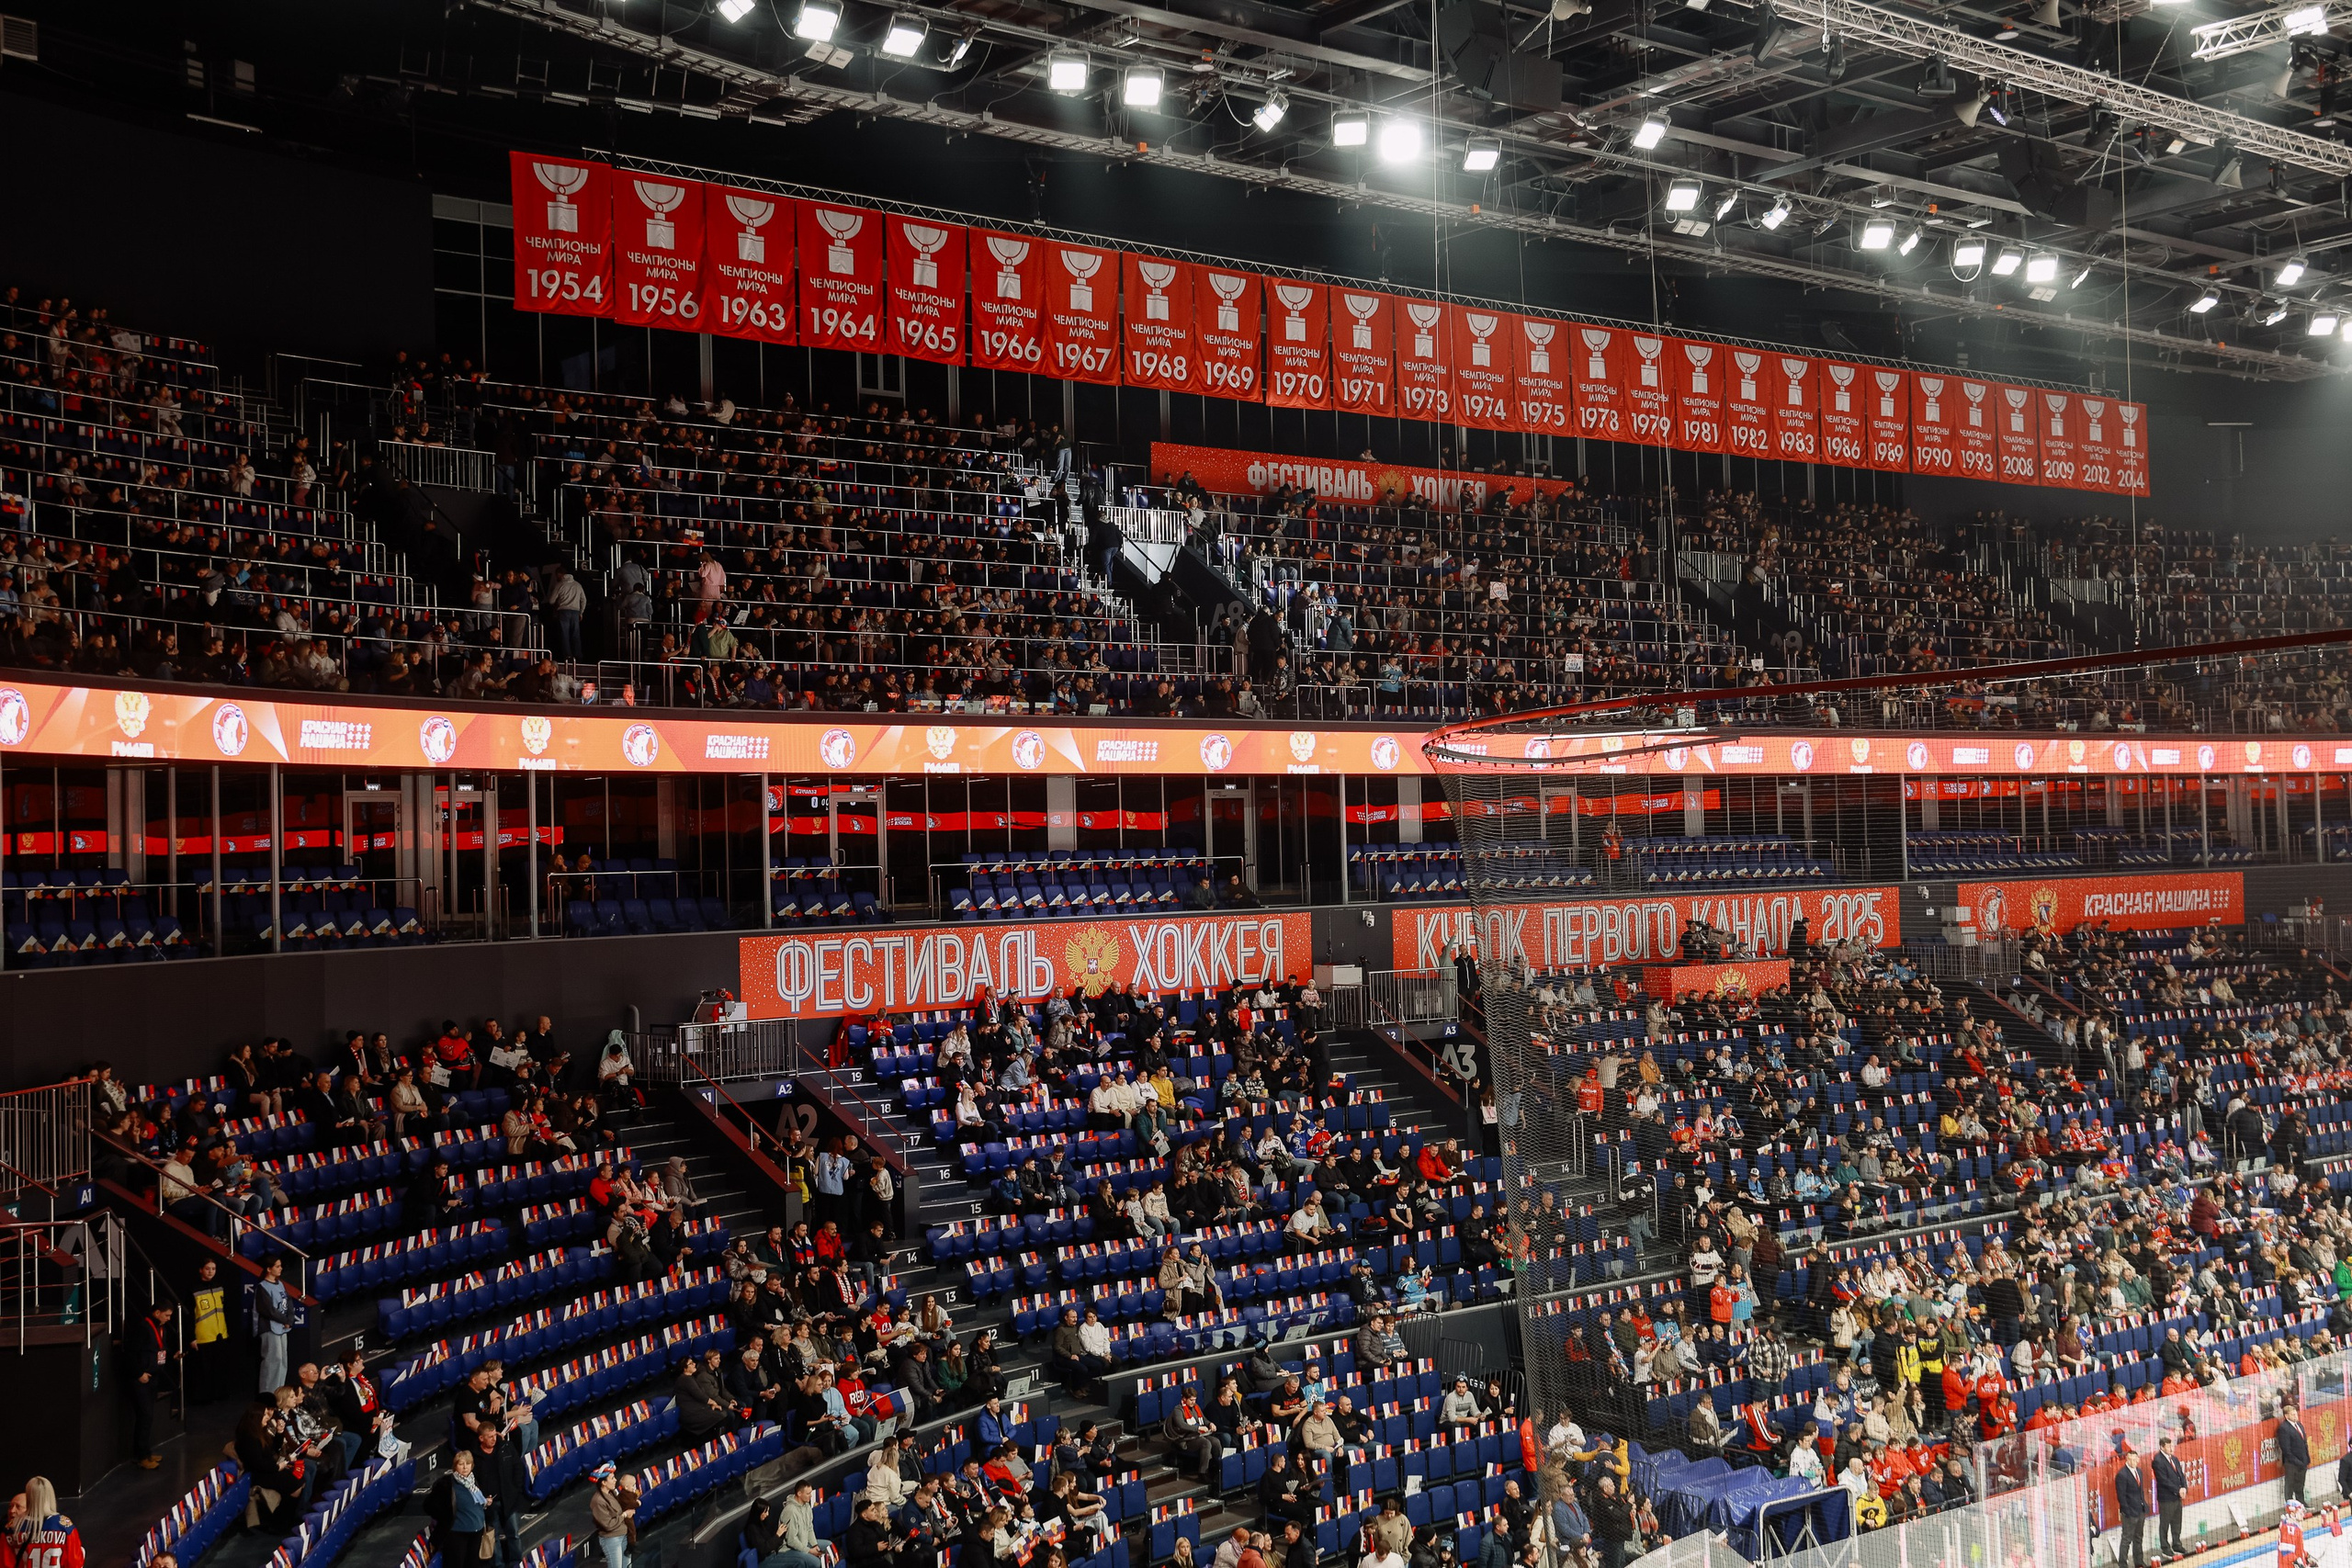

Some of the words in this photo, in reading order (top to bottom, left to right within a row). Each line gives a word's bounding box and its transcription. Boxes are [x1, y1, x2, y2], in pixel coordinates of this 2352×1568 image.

[526, 236, 601, 254] ЧЕМПИОНЫ
[547, 252, 582, 265] МИРА
[628, 252, 696, 271] ЧЕМПИОНЫ
[646, 266, 678, 281] МИРА
[719, 264, 783, 286] ЧЕМПИОНЫ
[527, 268, 603, 304] 1954
[737, 279, 768, 295] МИРА
[809, 277, 873, 295] ЧЕМПИОНЫ
[628, 283, 699, 319] 1956
[828, 290, 857, 306] МИРА
[896, 288, 956, 309] ЧЕМПИОНЫ
[720, 295, 786, 331] 1963
[911, 303, 940, 318] МИРА
[981, 301, 1037, 319] ЧЕМПИОНЫ
[810, 307, 876, 340] 1964
[996, 315, 1023, 328] МИРА
[1054, 314, 1109, 331] ЧЕМПИОНЫ
[897, 317, 956, 352] 1965
[1069, 327, 1095, 340] МИРА
[1131, 323, 1185, 339] ЧЕМПИОНЫ
[981, 330, 1041, 362] 1966
[1147, 336, 1171, 348] МИРА
[1204, 334, 1252, 350] ЧЕМПИОНЫ
[1056, 343, 1111, 372] 1967
[1217, 346, 1240, 358] МИРА
[1273, 345, 1319, 358] ЧЕМПИОНЫ
[1132, 351, 1187, 380] 1968
[1285, 356, 1307, 367] МИРА
[1340, 353, 1386, 367] ЧЕМПИОНЫ
[1204, 361, 1254, 390] 1969
[1352, 364, 1374, 375] МИРА
[1403, 361, 1446, 375] ЧЕМПИОНЫ
[1415, 373, 1435, 383] МИРА
[1460, 370, 1504, 383] ЧЕМПИОНЫ
[1519, 377, 1562, 389] ЧЕМПИОНЫ
[1274, 371, 1322, 399] 1970
[1341, 378, 1385, 405] 1971
[1472, 381, 1492, 391] МИРА
[1579, 383, 1617, 396] ЧЕМПИОНЫ
[1405, 386, 1448, 412] 1973
[1531, 388, 1552, 398] МИРА
[1589, 393, 1609, 402] МИРА
[1631, 389, 1668, 401] ЧЕМПИОНЫ
[1463, 394, 1506, 420] 1974
[1641, 400, 1659, 410] МИРА
[1682, 397, 1719, 409] ЧЕМПИОНЫ
[1730, 403, 1766, 415] ЧЕМПИОНЫ
[1521, 401, 1565, 426] 1975
[1580, 407, 1619, 431] 1978
[1691, 407, 1711, 416] МИРА
[1779, 409, 1813, 420] ЧЕМПИОНЫ
[1632, 412, 1670, 437] 1979
[1826, 415, 1860, 426] ЧЕМПИОНЫ
[1873, 421, 1903, 431] ЧЕМПИОНЫ
[1684, 420, 1718, 444] 1981
[1917, 425, 1949, 435] ЧЕМПИОНЫ
[1960, 429, 1991, 441] ЧЕМПИОНЫ
[1732, 426, 1768, 450] 1982
[1781, 431, 1814, 455] 1983
[1826, 437, 1860, 459] 1986
[1874, 442, 1904, 463] 1989
[1917, 446, 1951, 468] 1990
[1962, 450, 1993, 472] 1993
[2003, 456, 2034, 477] 2008
[2043, 460, 2075, 480] 2009
[1247, 460, 1373, 501] ФЕСТИВАЛЬ
[1209, 600, 1245, 637] A8
[707, 734, 748, 747] КРАСНАЯ
[1098, 739, 1137, 751] КРАСНАЯ
[705, 745, 748, 759] МАШИНА
[1096, 749, 1136, 761] МАШИНА
[2084, 891, 2153, 917] КРАСНАЯ
[2156, 888, 2211, 914] МАШИНА
[1542, 901, 1679, 965] ПЕРВОГО
[1821, 892, 1884, 946] 2025
[775, 929, 1055, 1013] ФЕСТИВАЛЬ
[1128, 919, 1284, 990] ХОККЕЯ
[1444, 1026, 1456, 1036] A3
[1440, 1043, 1477, 1081] A3
[851, 1071, 863, 1082] 19
[777, 1083, 793, 1096] A2
[880, 1103, 892, 1113] 18
[775, 1103, 820, 1147] A2
[910, 1134, 921, 1146] 17
[939, 1168, 950, 1179] 16
[1562, 1164, 1569, 1174] 14
[80, 1188, 92, 1205] A1
[1564, 1198, 1573, 1208] 13
[1597, 1194, 1605, 1203] 13
[970, 1202, 982, 1214] 15
[1600, 1229, 1610, 1239] 12
[906, 1251, 917, 1264] 14
[1639, 1260, 1646, 1271] 11
[945, 1292, 956, 1303] 13
[355, 1336, 364, 1351] 15
[1031, 1369, 1040, 1382] 11
[849, 1390, 865, 1405] RED
[428, 1453, 437, 1470] 13
[582, 1542, 590, 1559] 11
